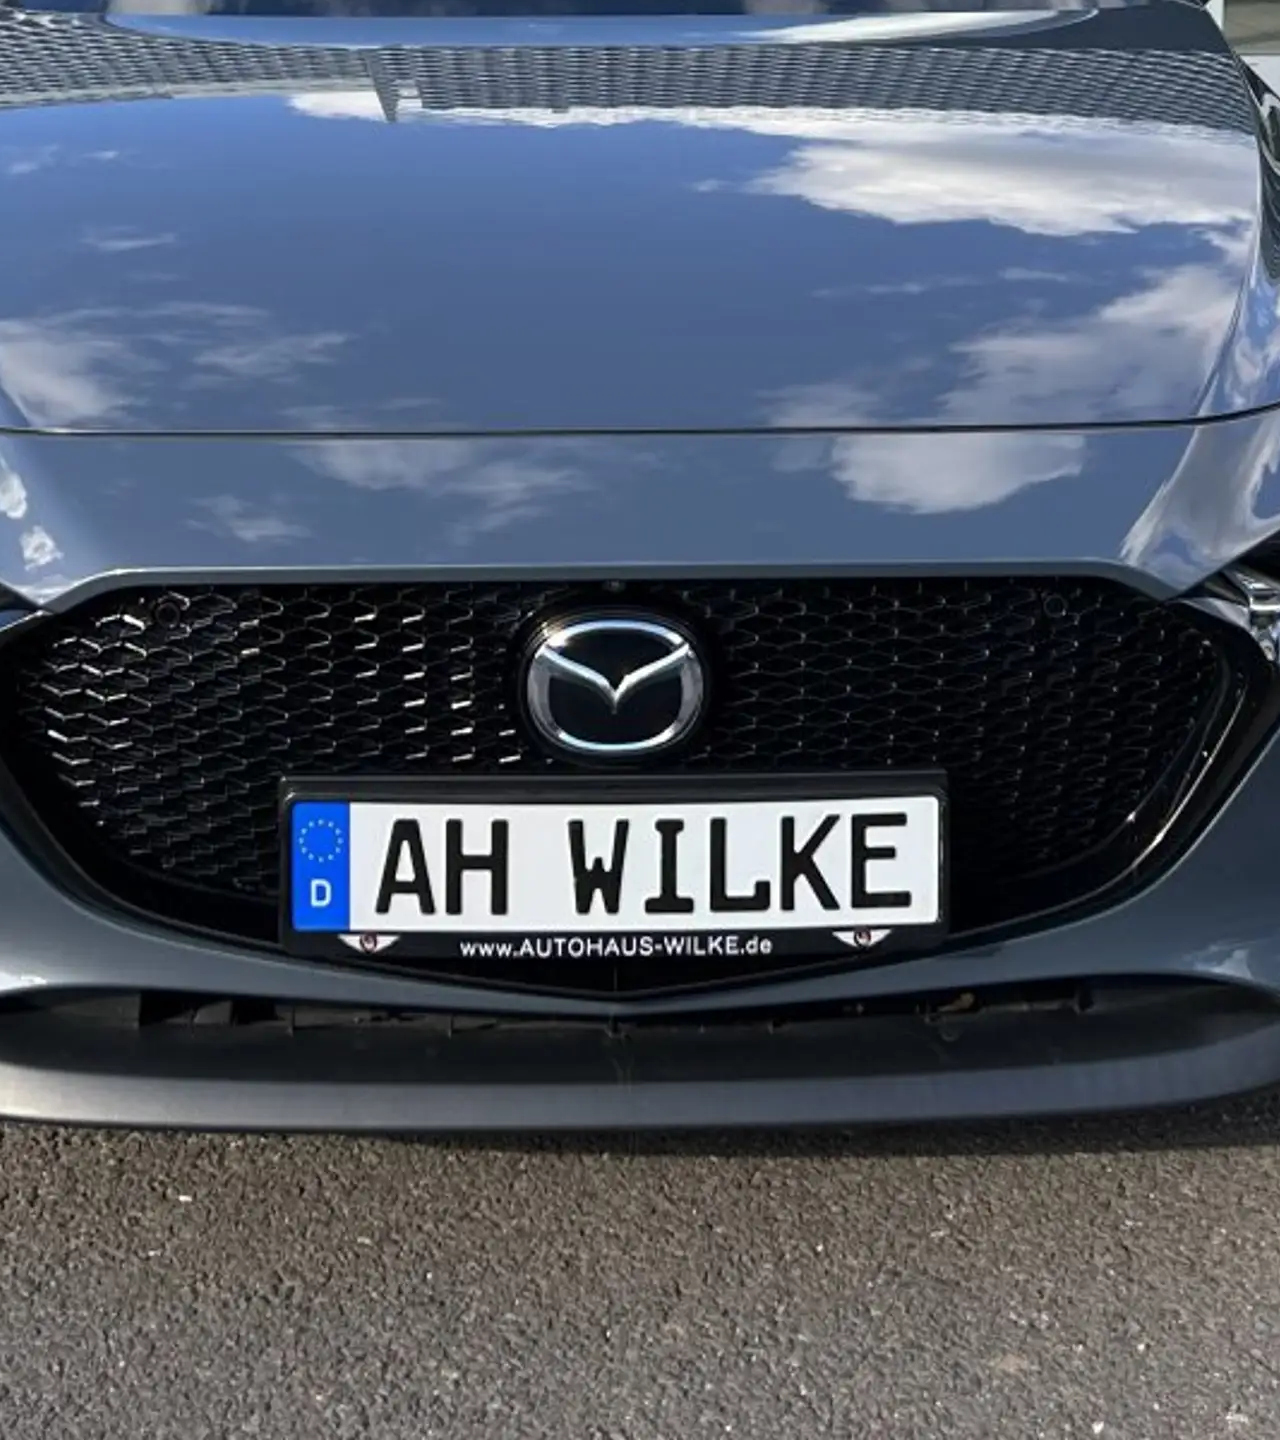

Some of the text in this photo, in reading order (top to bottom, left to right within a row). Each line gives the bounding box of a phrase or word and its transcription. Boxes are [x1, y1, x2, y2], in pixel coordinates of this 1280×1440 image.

[375, 812, 912, 916] AH WILKE
[310, 878, 332, 908] D
[459, 936, 774, 959] www.AUTOHAUS-WILKE.de
